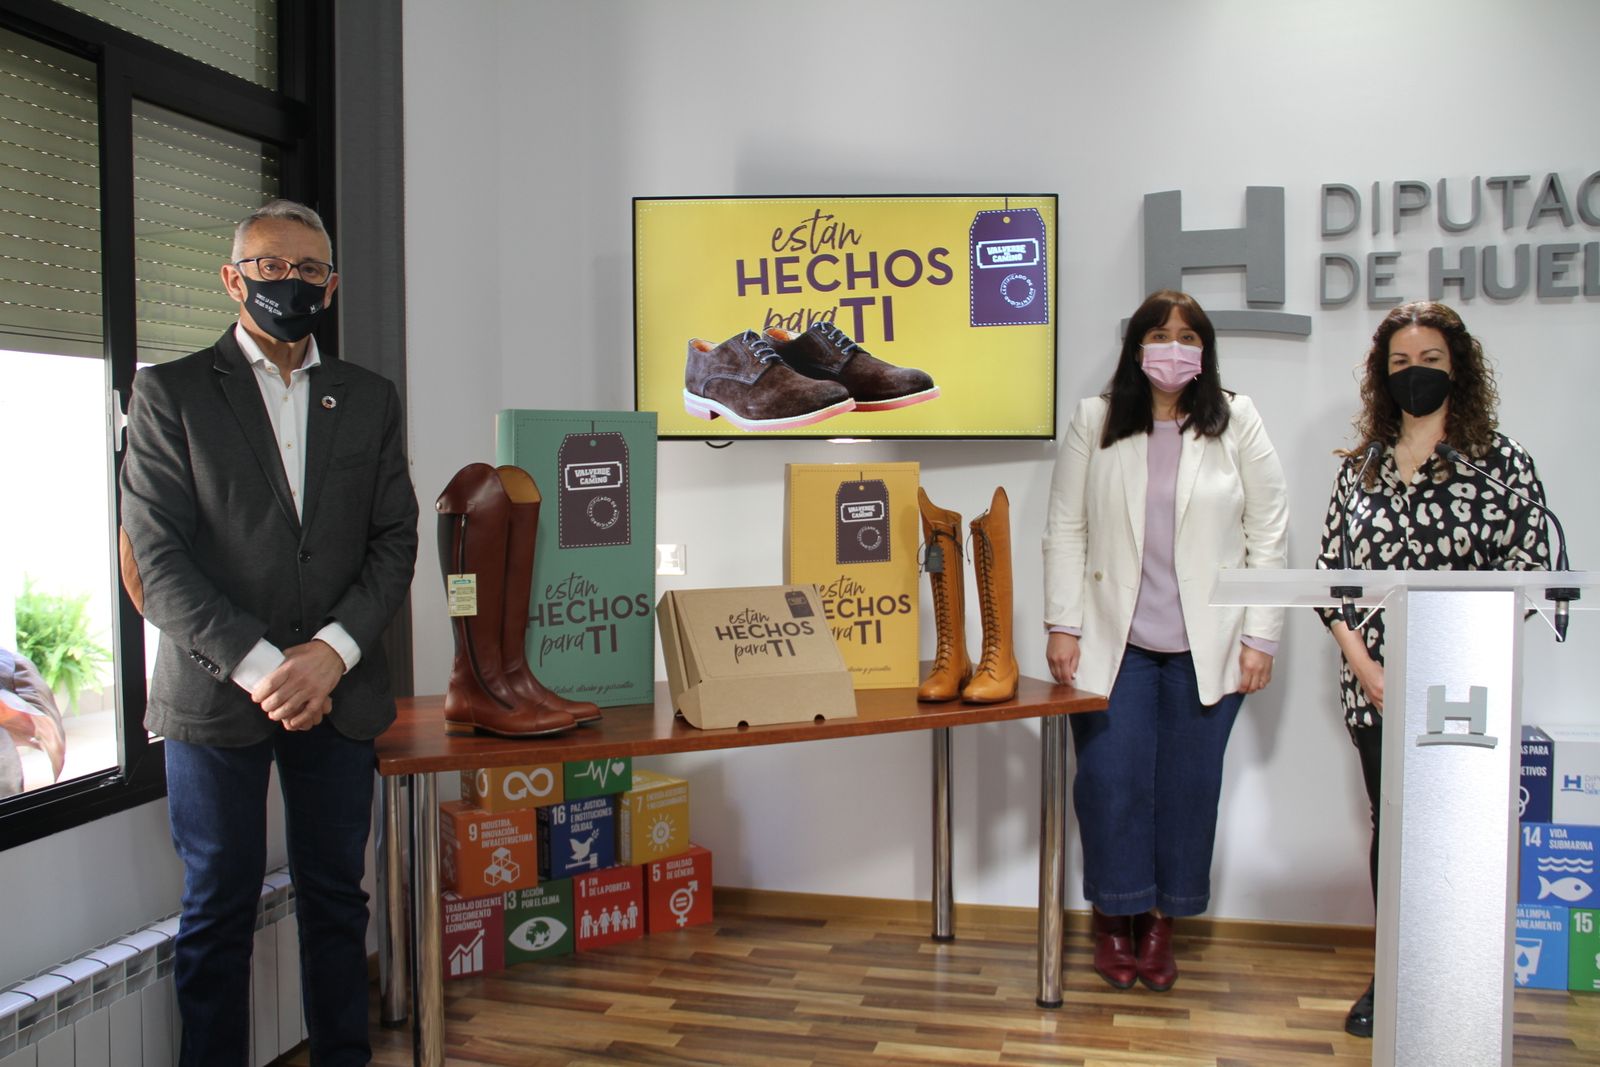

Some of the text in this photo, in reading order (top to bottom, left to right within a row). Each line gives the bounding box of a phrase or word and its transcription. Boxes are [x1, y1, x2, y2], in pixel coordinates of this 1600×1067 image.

[771, 209, 862, 254] están
[736, 247, 953, 296] HECHOS
[1320, 242, 1600, 307] DE HUEL
[839, 296, 894, 343] TI
[545, 572, 599, 600] están
[820, 575, 865, 599] están
[527, 593, 650, 628] HECHOS
[728, 608, 769, 625] están
[822, 594, 911, 619] ECHOS
[715, 621, 815, 640] HECHOS
[854, 620, 881, 645] TI
[540, 624, 618, 668] para TI
[734, 639, 796, 664] para TI
[1529, 745, 1549, 756] PARA
[1521, 766, 1547, 777] ETIVOS
[552, 805, 566, 825] 16
[583, 799, 607, 811] JUSTICIA
[574, 807, 613, 821] INSTITUCIONES
[468, 823, 478, 842] 9
[571, 821, 593, 833] SÓLIDAS
[1523, 826, 1567, 847] 14 VIDA
[1549, 839, 1593, 851] SUBMARINA
[652, 858, 693, 882] 5 IGUALDAD
[666, 866, 694, 880] DE GÉNERO
[580, 877, 598, 898] 1 FIN
[589, 881, 631, 896] DE LA POBREZA
[446, 896, 502, 913] TRABAJO DECENTE
[504, 887, 543, 910] 13 ACCIÓN
[522, 895, 560, 909] POR EL CLIMA
[446, 908, 491, 923] Y CRECIMIENTO
[1516, 912, 1593, 933] ANEAMIENTO 15
[1526, 909, 1550, 920] LIMPIA
[446, 919, 482, 933] ECONÓMICO
